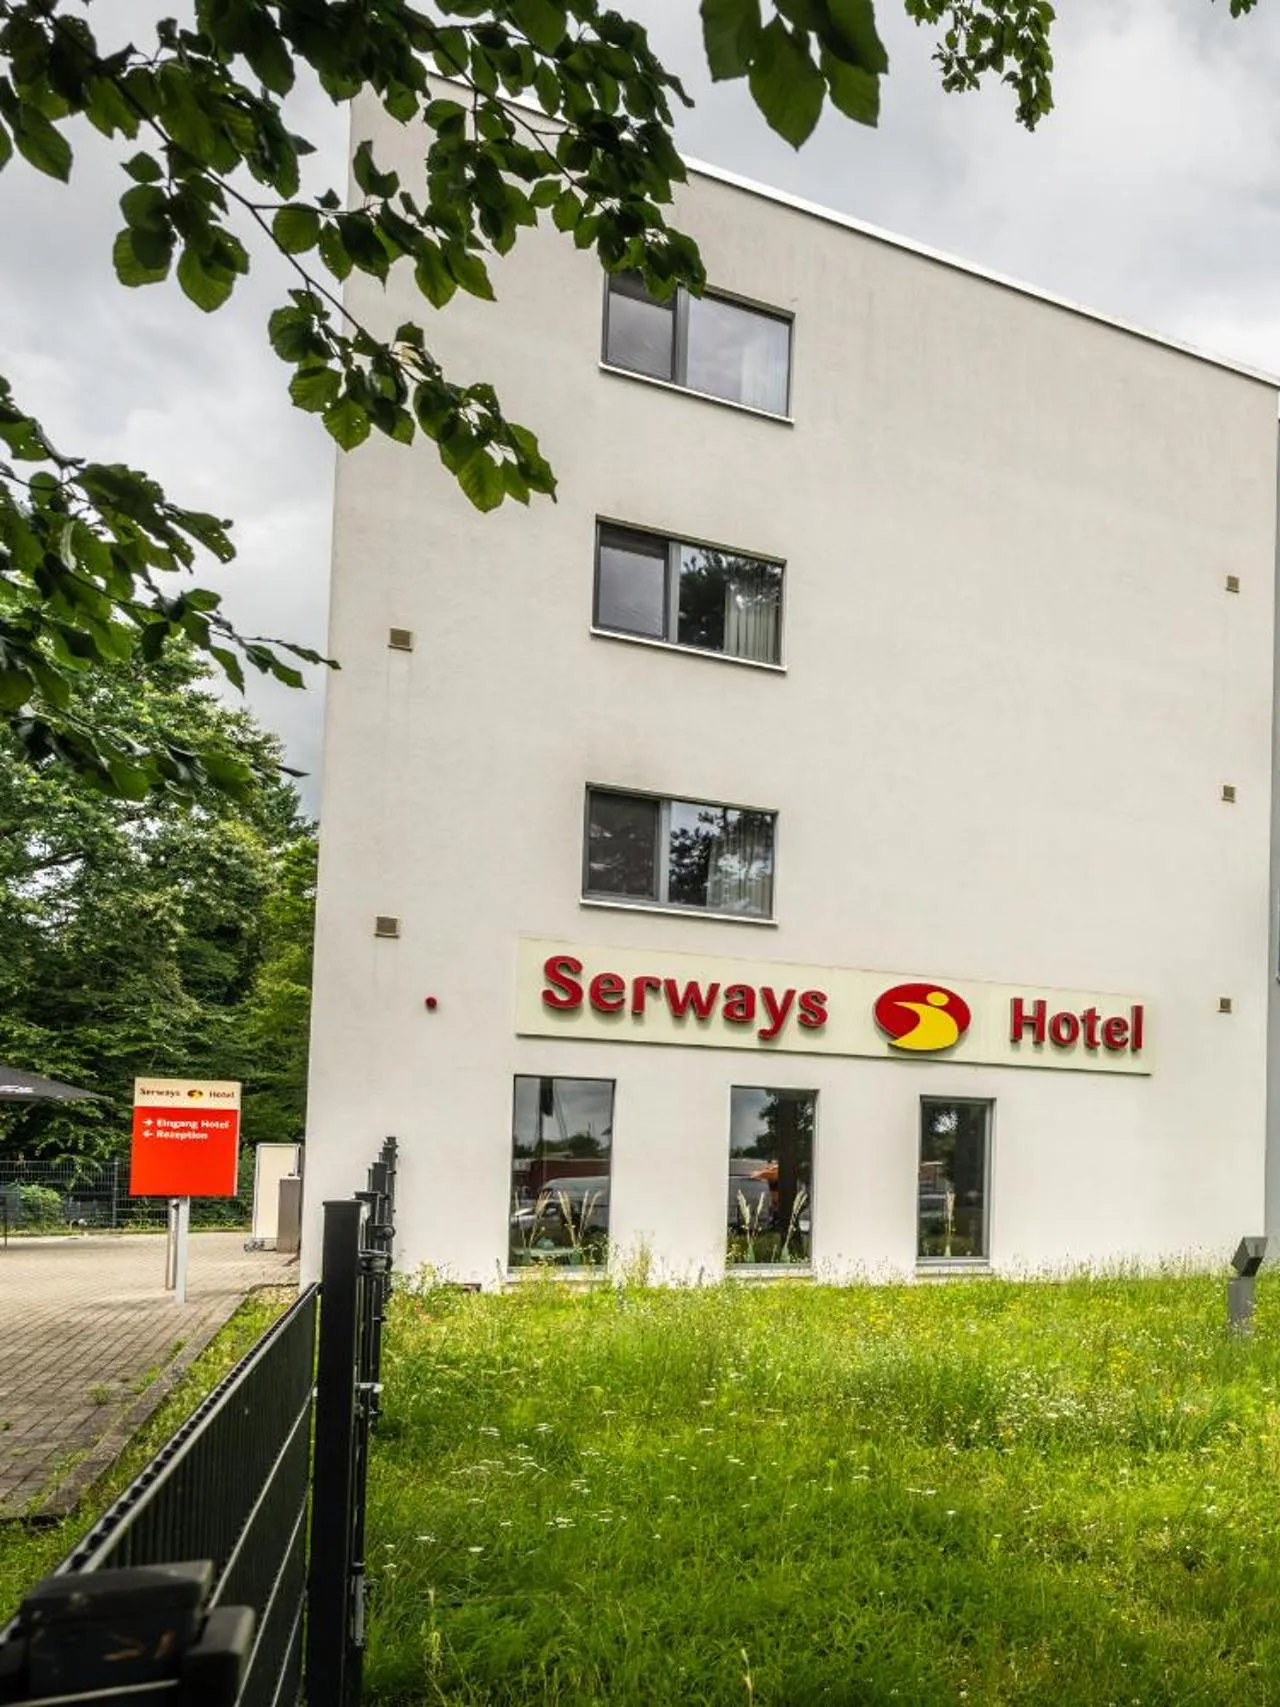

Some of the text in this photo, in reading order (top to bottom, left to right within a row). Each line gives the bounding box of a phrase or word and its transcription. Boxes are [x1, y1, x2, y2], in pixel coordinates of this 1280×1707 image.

[541, 955, 1144, 1050] Serways Hotel
[140, 1087, 235, 1099] Serways Hotel
[156, 1118, 229, 1129] Eingang Hotel
[156, 1129, 208, 1140] Rezeption
